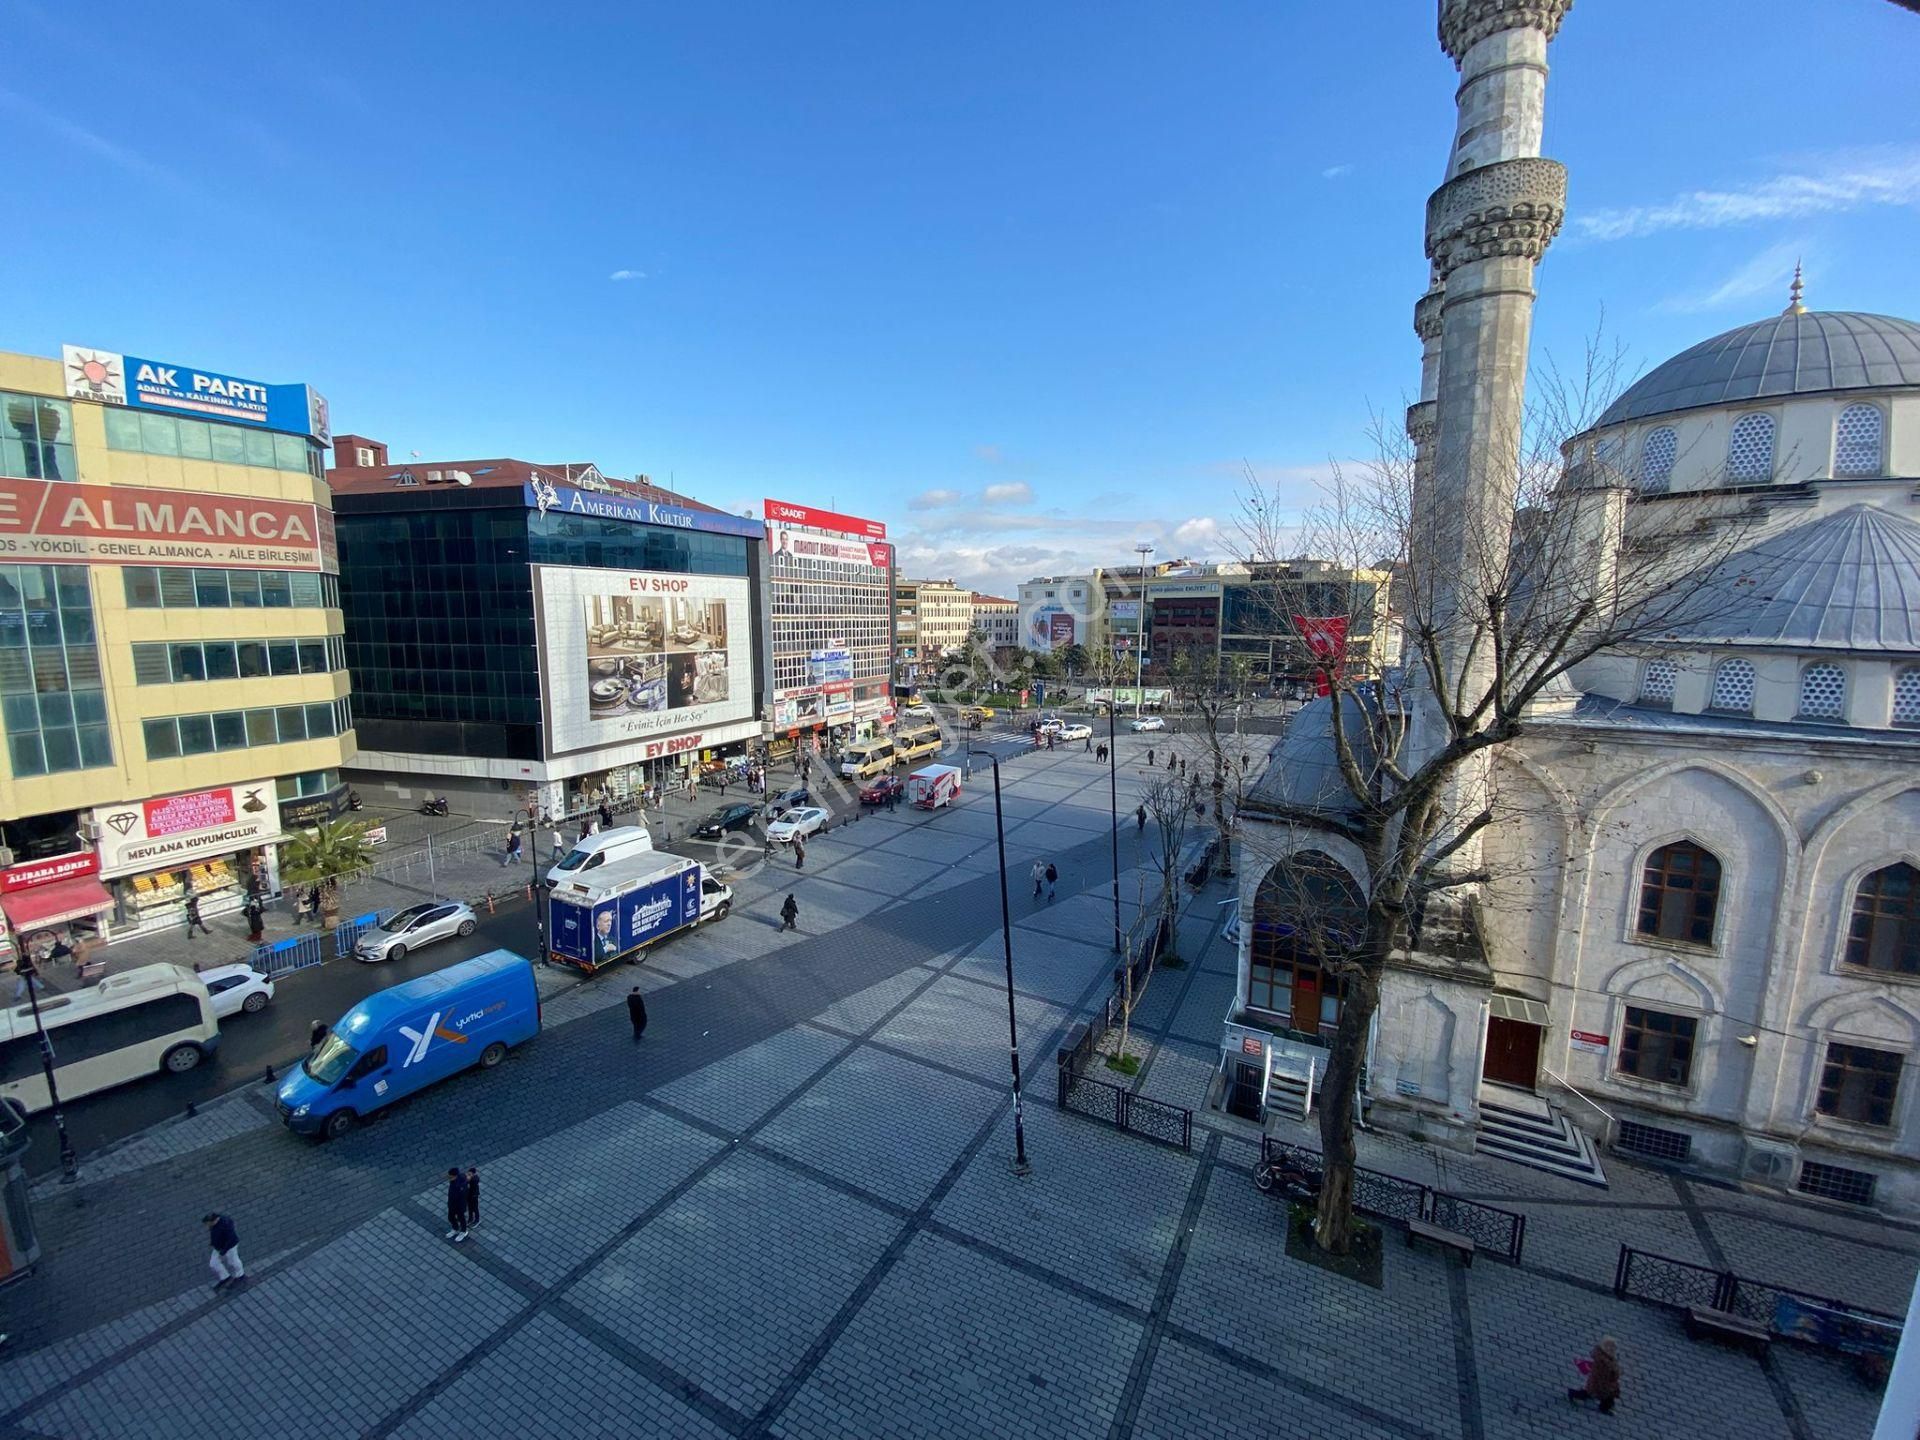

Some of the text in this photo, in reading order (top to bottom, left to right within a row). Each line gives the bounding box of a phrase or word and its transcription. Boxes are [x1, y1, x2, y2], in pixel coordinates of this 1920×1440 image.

[136, 364, 179, 388] AK
[136, 384, 171, 396] ADALET
[186, 391, 235, 407] KALKINMA
[60, 497, 312, 542] ALMANCA
[780, 506, 806, 520] SAADET
[30, 538, 86, 554] YÖKDİL
[98, 543, 146, 556] GENEL
[148, 546, 213, 559] ALMANCA
[229, 547, 255, 560] AİLE
[258, 549, 313, 564] BİRLEŞİMİ
[629, 577, 689, 592] EV SHOP
[655, 715, 672, 729] İçin
[674, 714, 689, 725] Her
[646, 734, 703, 759] EV SHOP
[128, 826, 258, 860] MEVLANA KUYUMCULUK
[8, 867, 55, 884] ALİBABA
[57, 859, 92, 873] BÖREK
